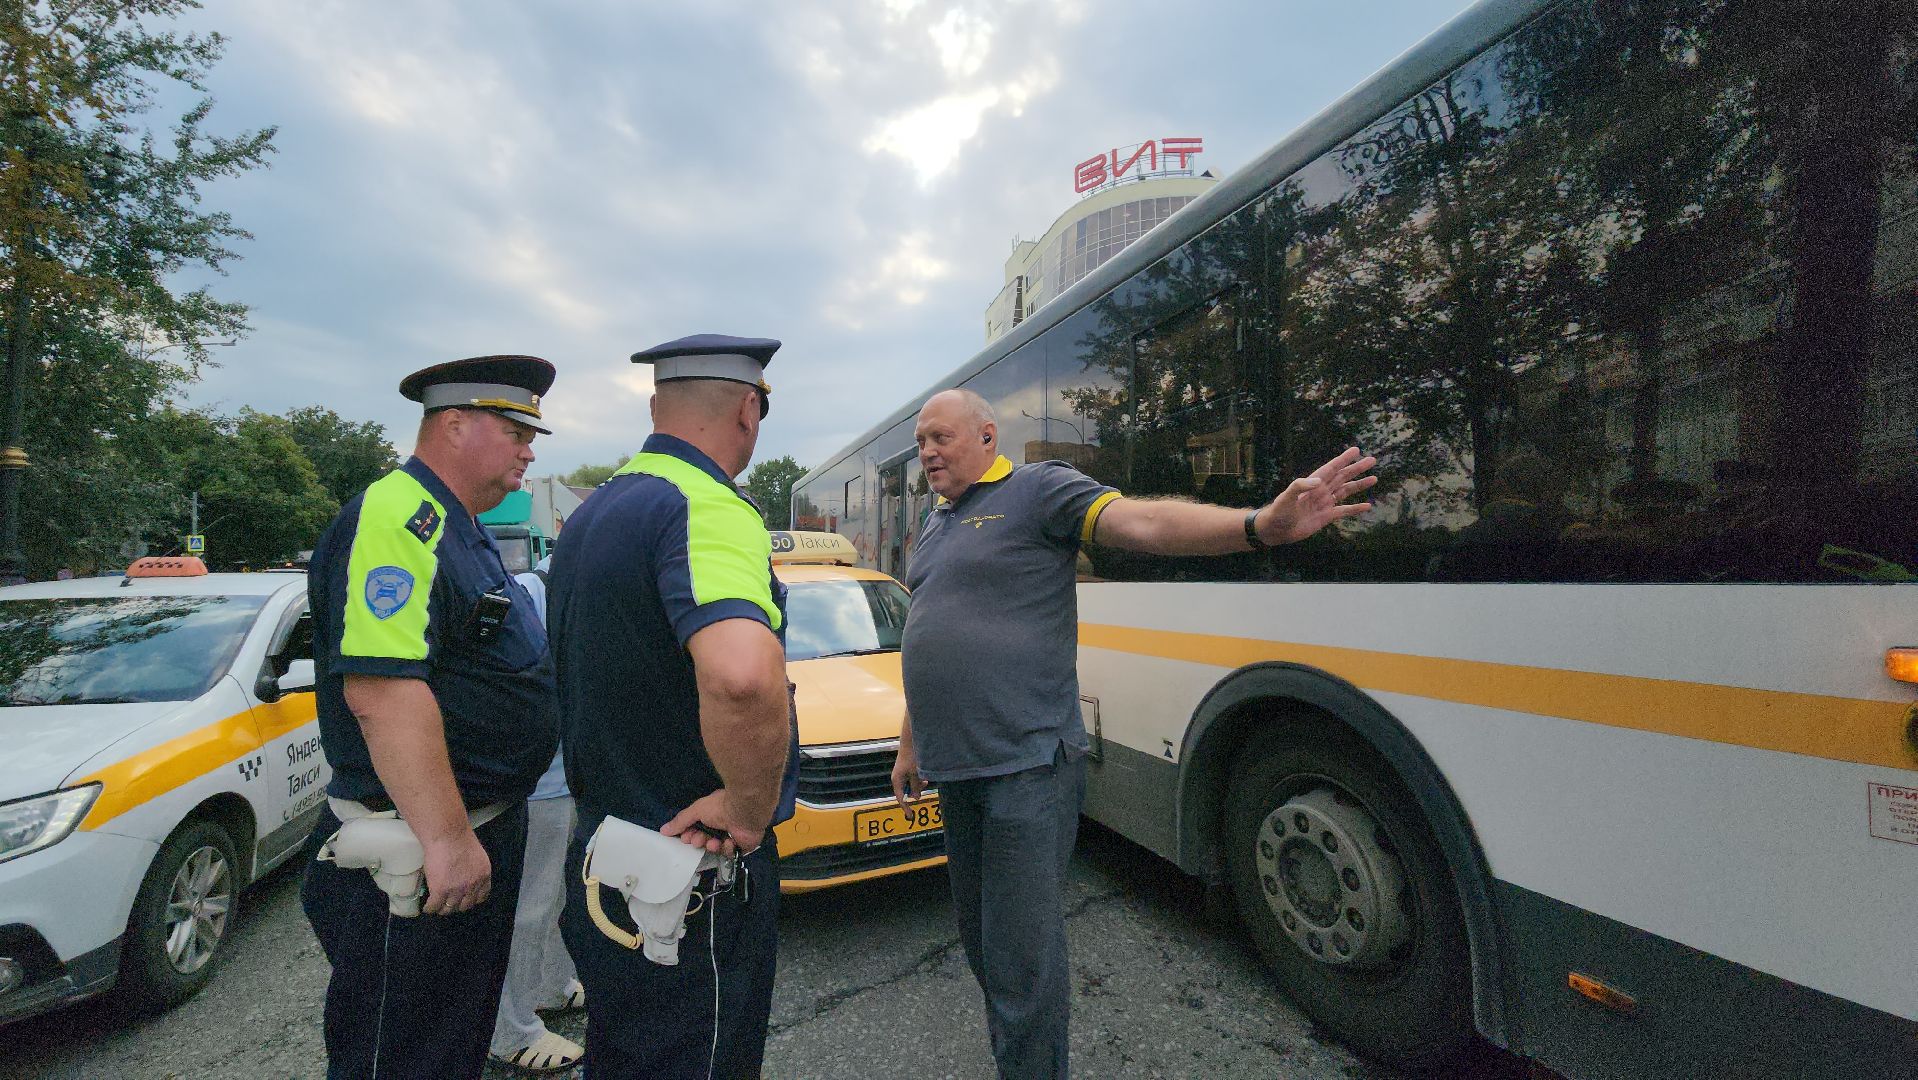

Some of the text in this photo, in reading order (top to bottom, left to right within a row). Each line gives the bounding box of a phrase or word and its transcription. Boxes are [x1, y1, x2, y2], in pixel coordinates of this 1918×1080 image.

[1074, 138, 1203, 193] ВИТ
[796, 534, 840, 549] Такси
[287, 763, 320, 797] Такси
[868, 803, 942, 837] ВС 983
